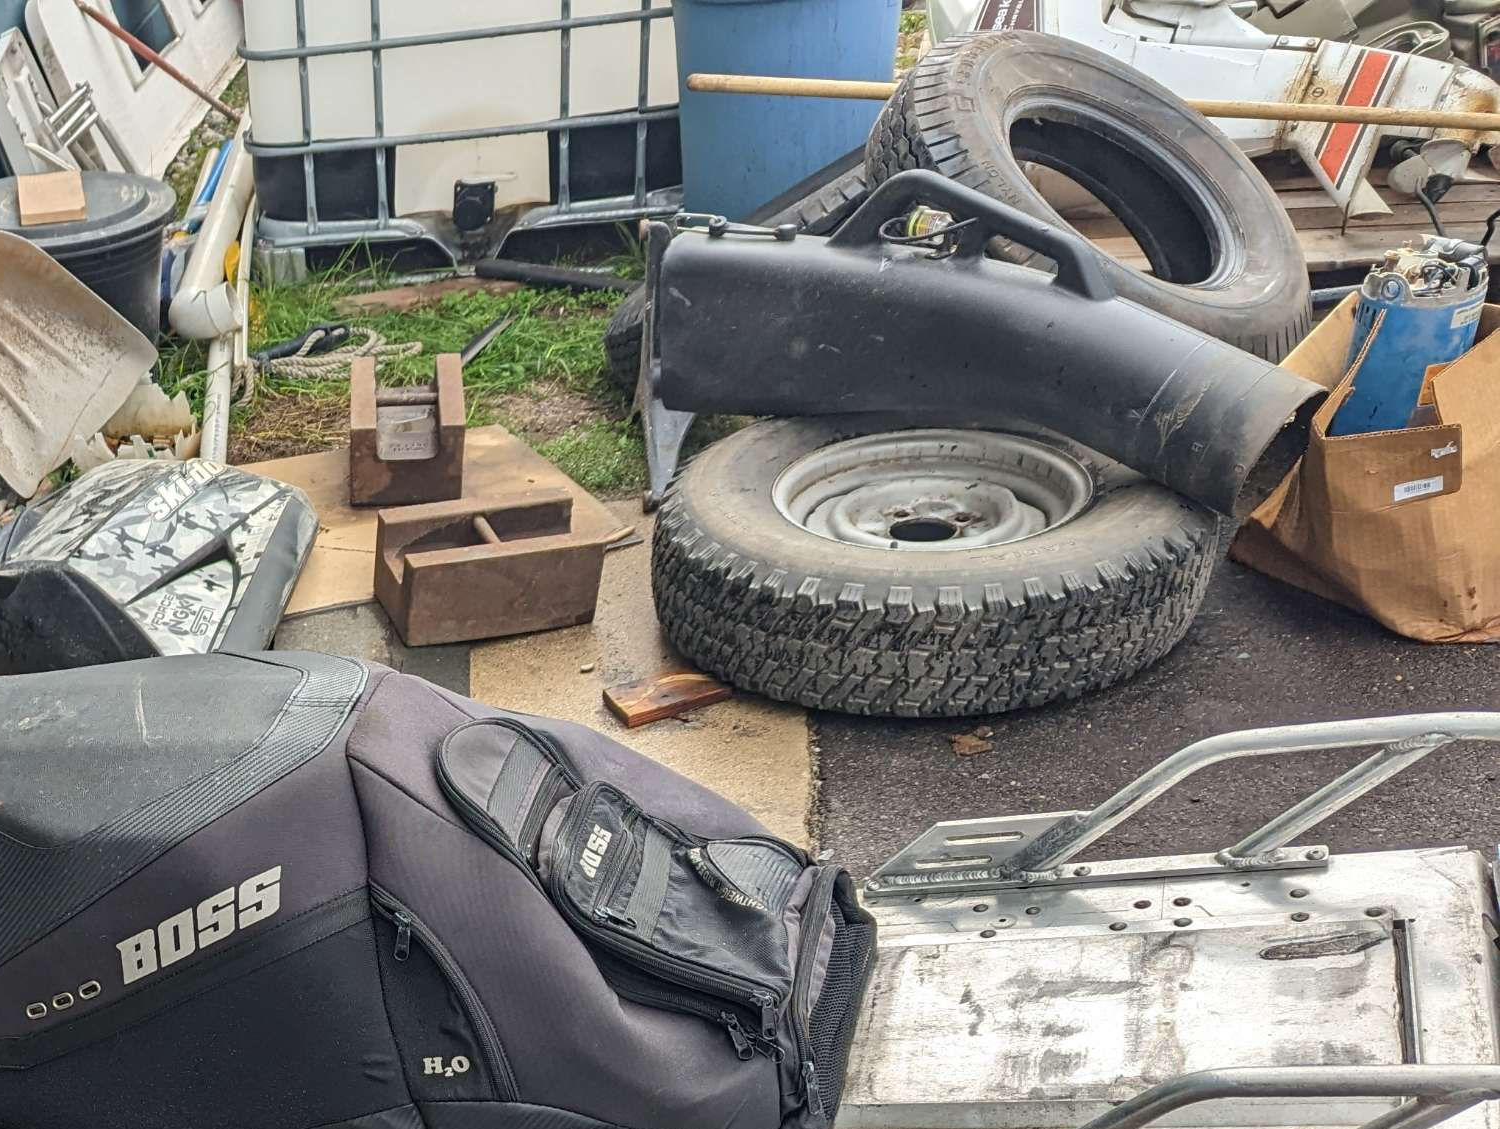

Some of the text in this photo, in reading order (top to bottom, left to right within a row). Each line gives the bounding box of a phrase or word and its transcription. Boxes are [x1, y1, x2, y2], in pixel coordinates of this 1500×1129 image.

[148, 594, 174, 631] VFORCE
[168, 599, 196, 632] NGK
[116, 865, 282, 985] BOSS
